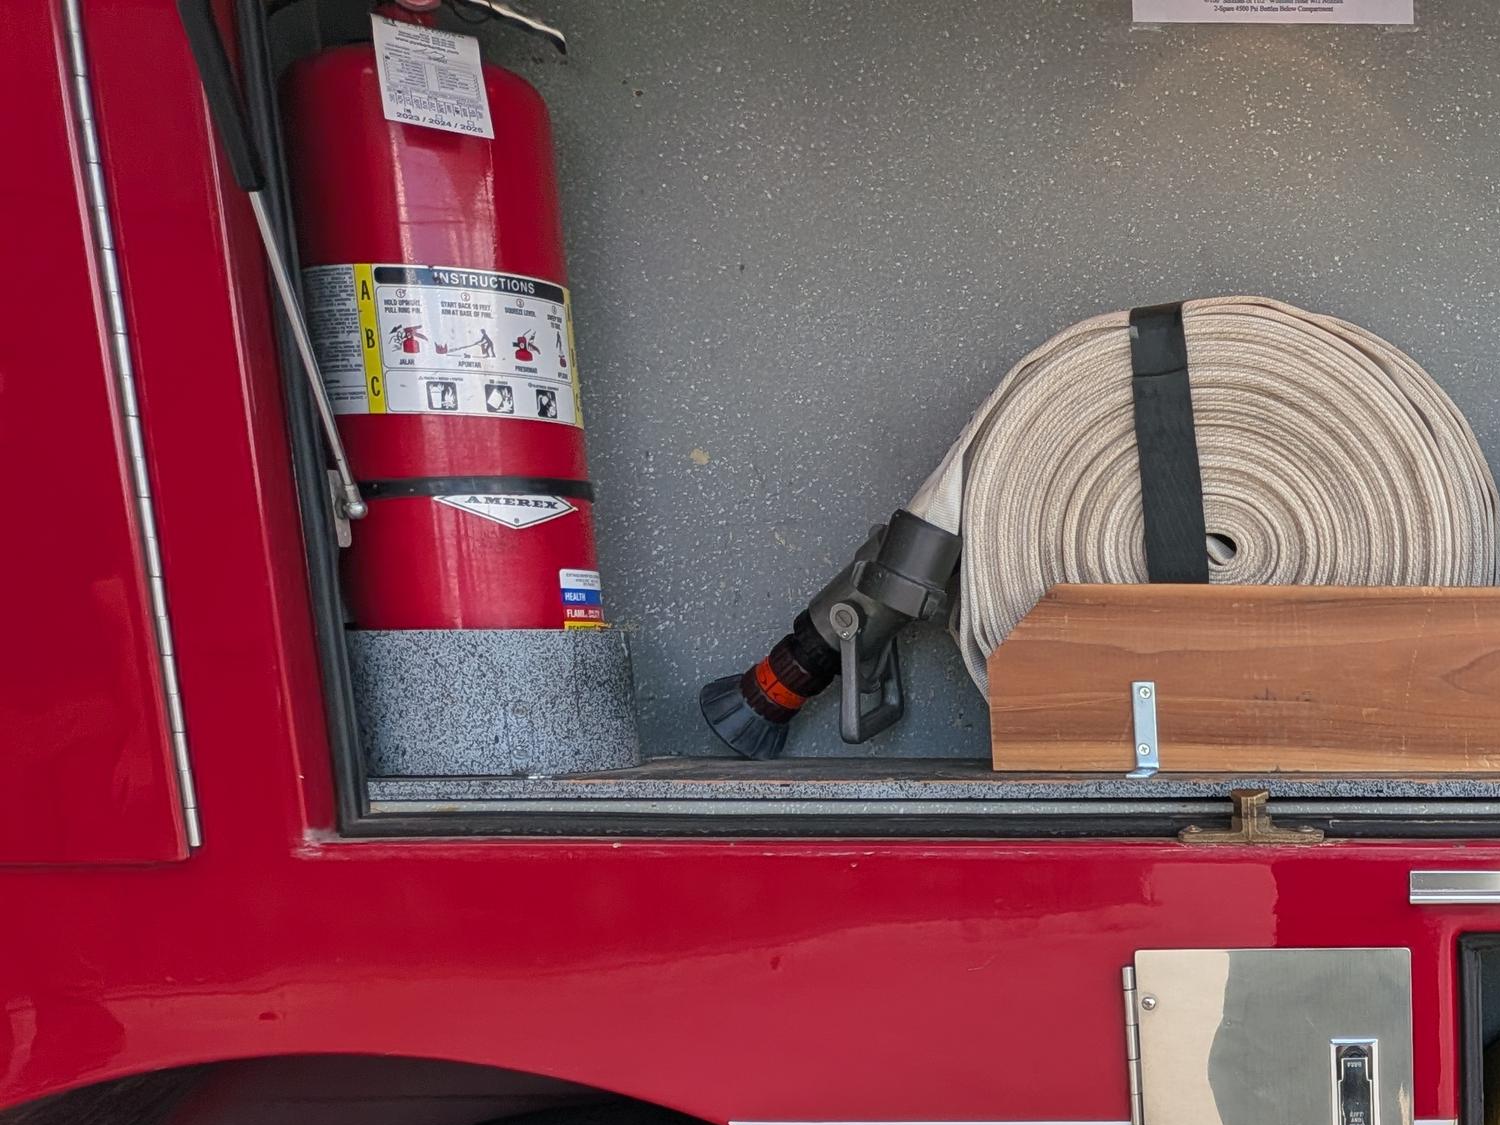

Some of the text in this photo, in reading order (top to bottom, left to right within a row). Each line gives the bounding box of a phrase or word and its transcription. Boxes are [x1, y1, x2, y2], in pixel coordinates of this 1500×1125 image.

[396, 112, 420, 121] 2023
[429, 118, 452, 128] 2024
[460, 124, 484, 134] 2025
[361, 280, 371, 301] A
[365, 328, 376, 349] B
[371, 376, 381, 397] C
[465, 496, 558, 510] AMEREX
[565, 592, 586, 602] HEALTH
